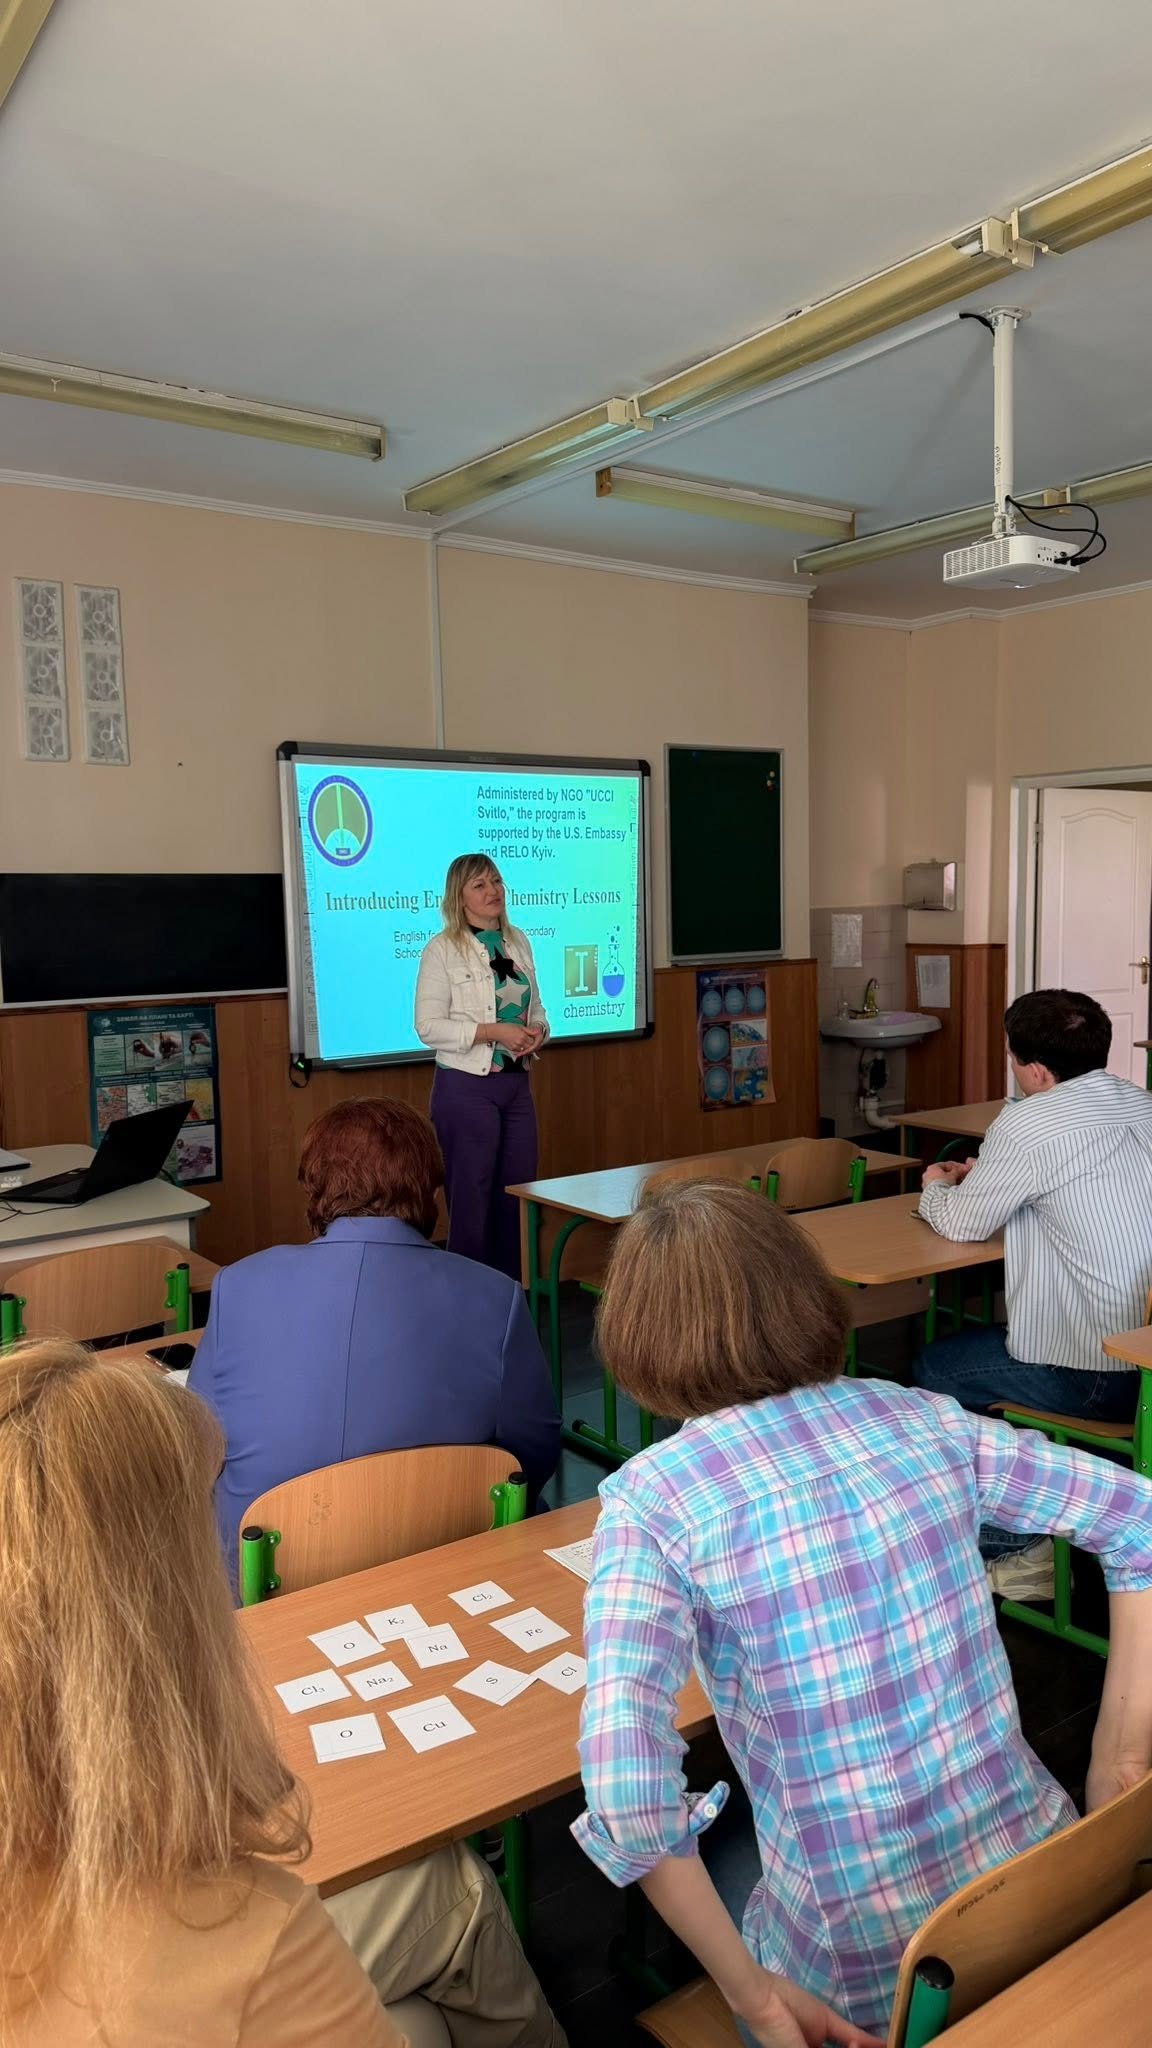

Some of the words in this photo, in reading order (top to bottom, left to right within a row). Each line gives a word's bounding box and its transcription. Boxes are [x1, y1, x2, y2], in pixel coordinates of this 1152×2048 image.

[477, 786, 544, 801] Administered
[547, 788, 559, 804] by
[561, 788, 584, 802] NGO
[586, 789, 614, 802] "UCCI
[517, 807, 533, 820] the
[535, 810, 576, 823] program
[578, 808, 587, 820] is
[478, 826, 529, 842] supported
[532, 826, 544, 842] by
[546, 826, 561, 839] the
[564, 827, 583, 839] U.S.
[585, 827, 627, 842] Embassy
[500, 845, 529, 858] RELO
[531, 846, 556, 861] Kyiv.
[325, 890, 420, 914] Introducing
[573, 887, 621, 904] Lessons
[394, 930, 426, 944] English
[563, 1001, 626, 1018] chemistry
[524, 1627, 544, 1637] Fe
[427, 1643, 448, 1654] Na
[485, 1676, 498, 1685] S
[422, 1720, 449, 1733] Cu
